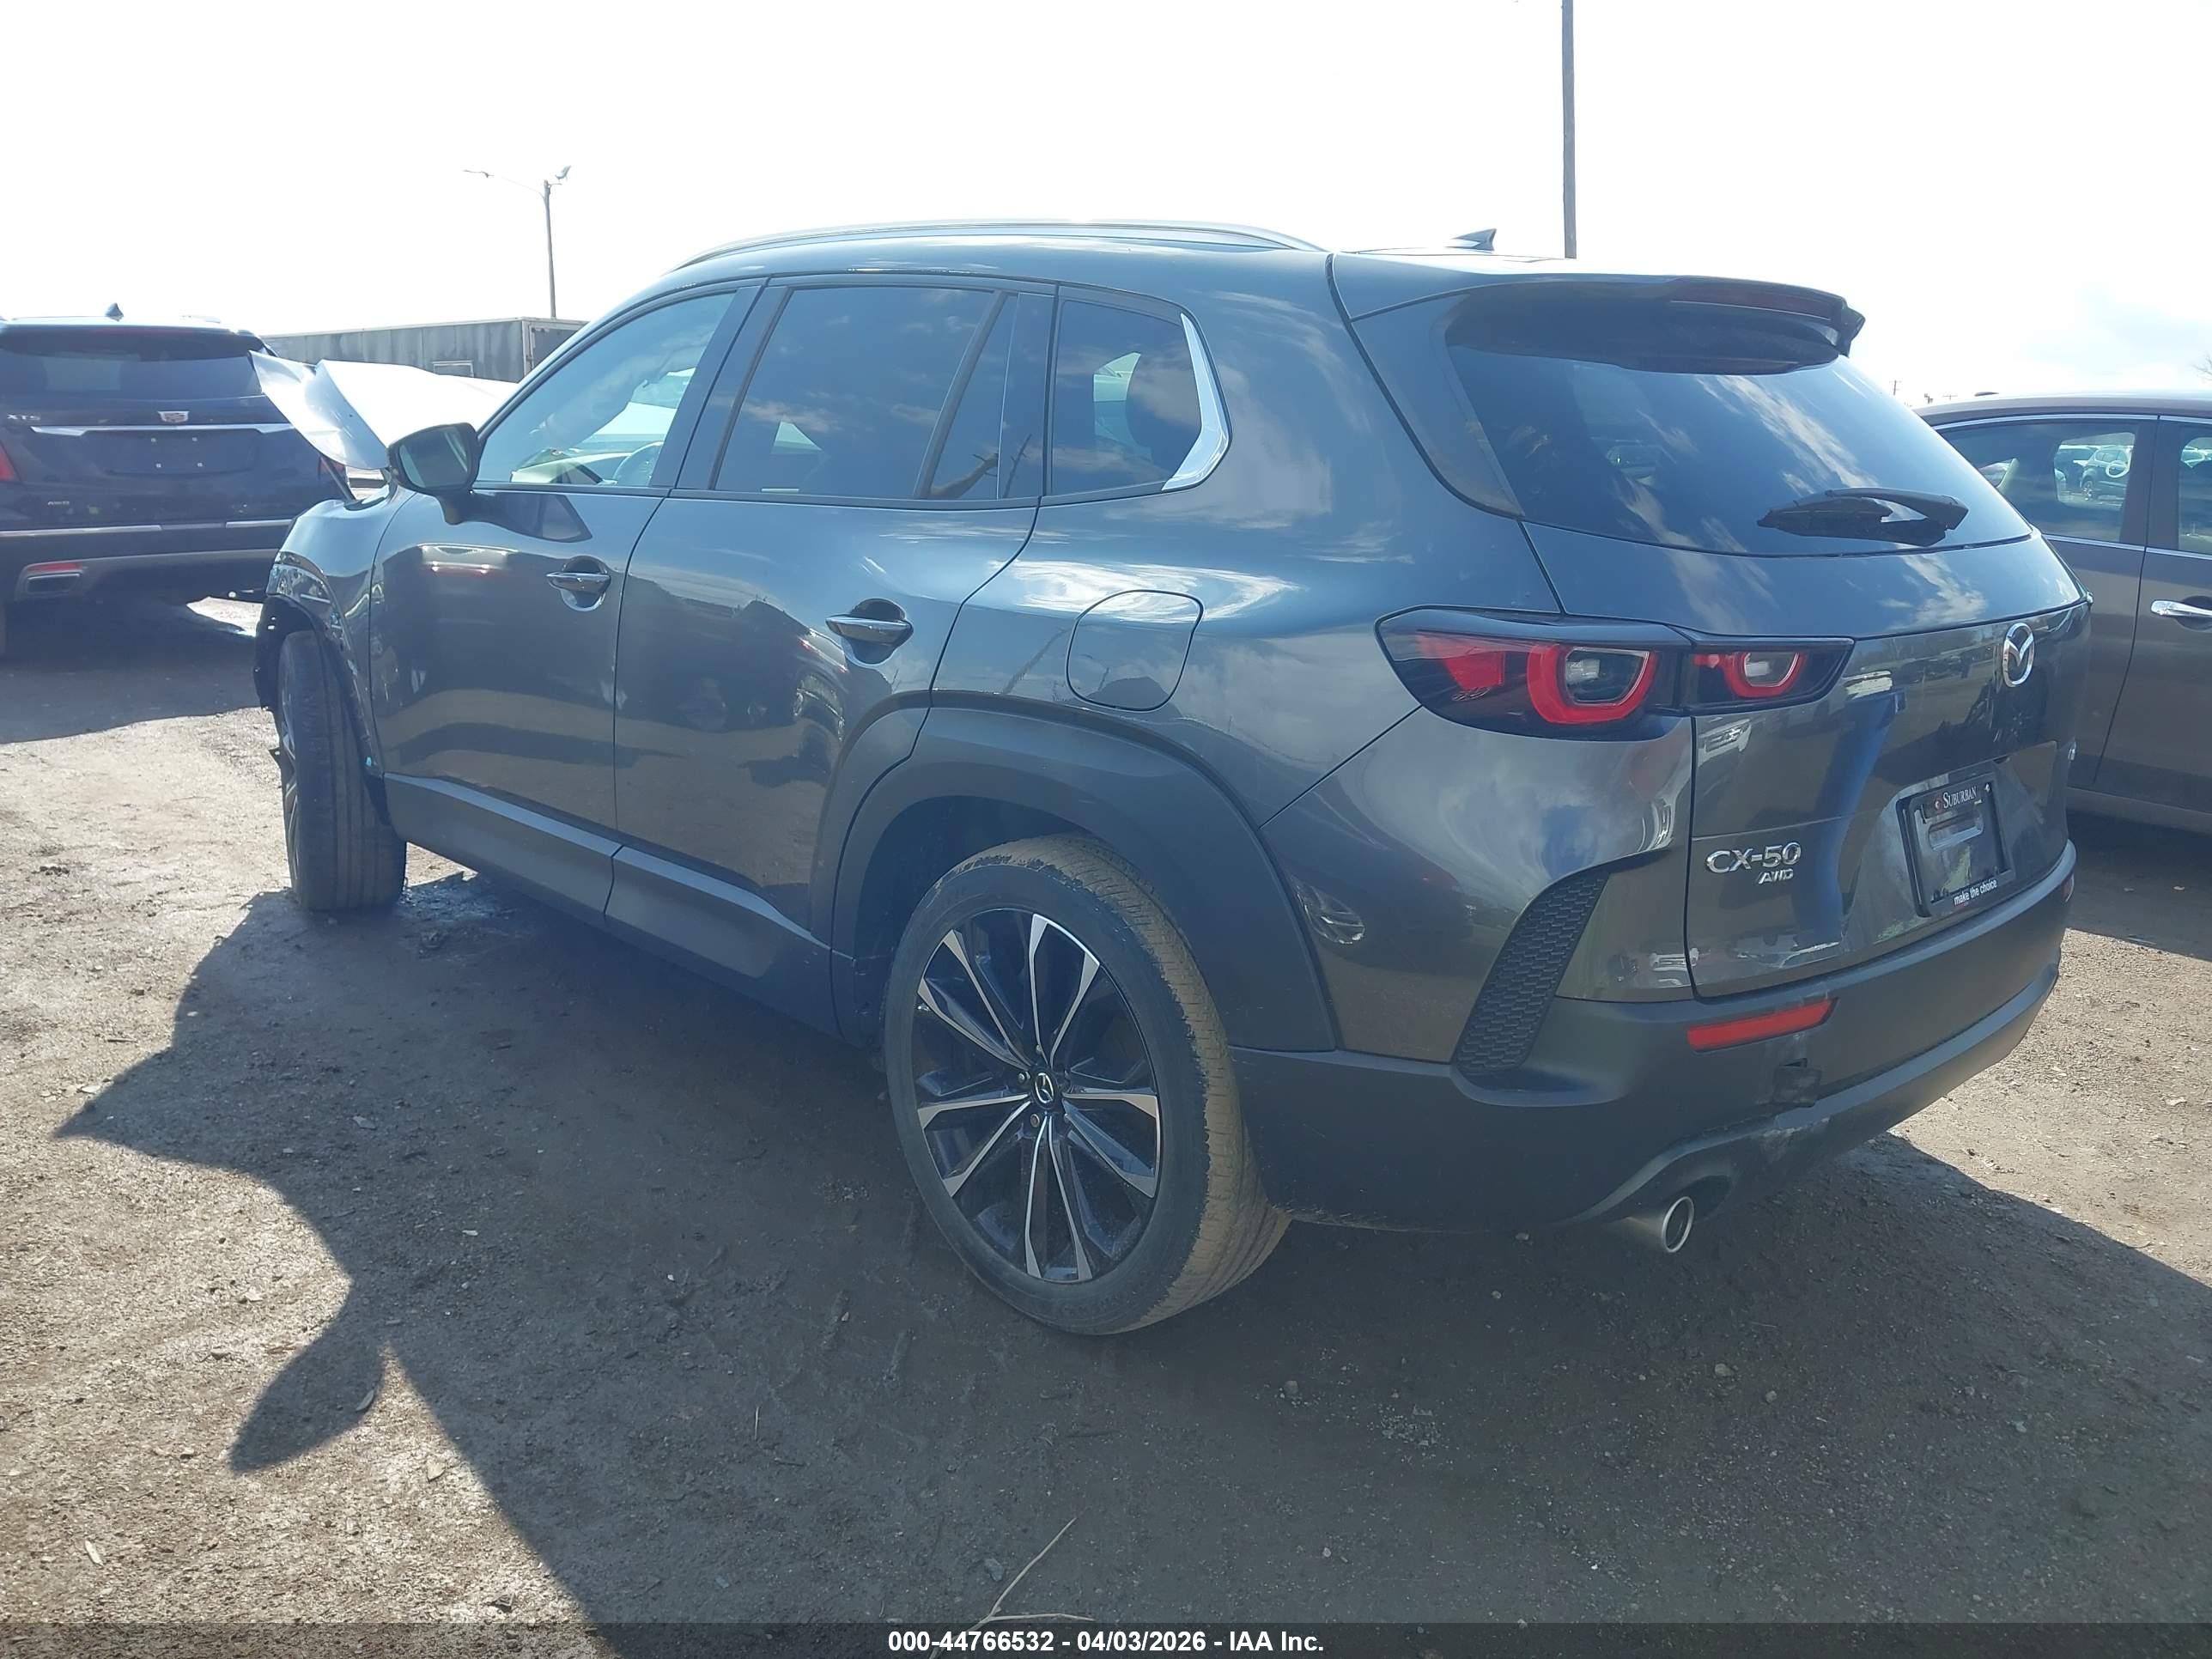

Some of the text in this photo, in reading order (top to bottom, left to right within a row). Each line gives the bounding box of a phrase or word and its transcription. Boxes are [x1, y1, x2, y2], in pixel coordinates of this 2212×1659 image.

[1705, 841, 1802, 874] CX-50
[1758, 868, 1794, 884] AWD
[1954, 879, 1997, 906] make the choice
